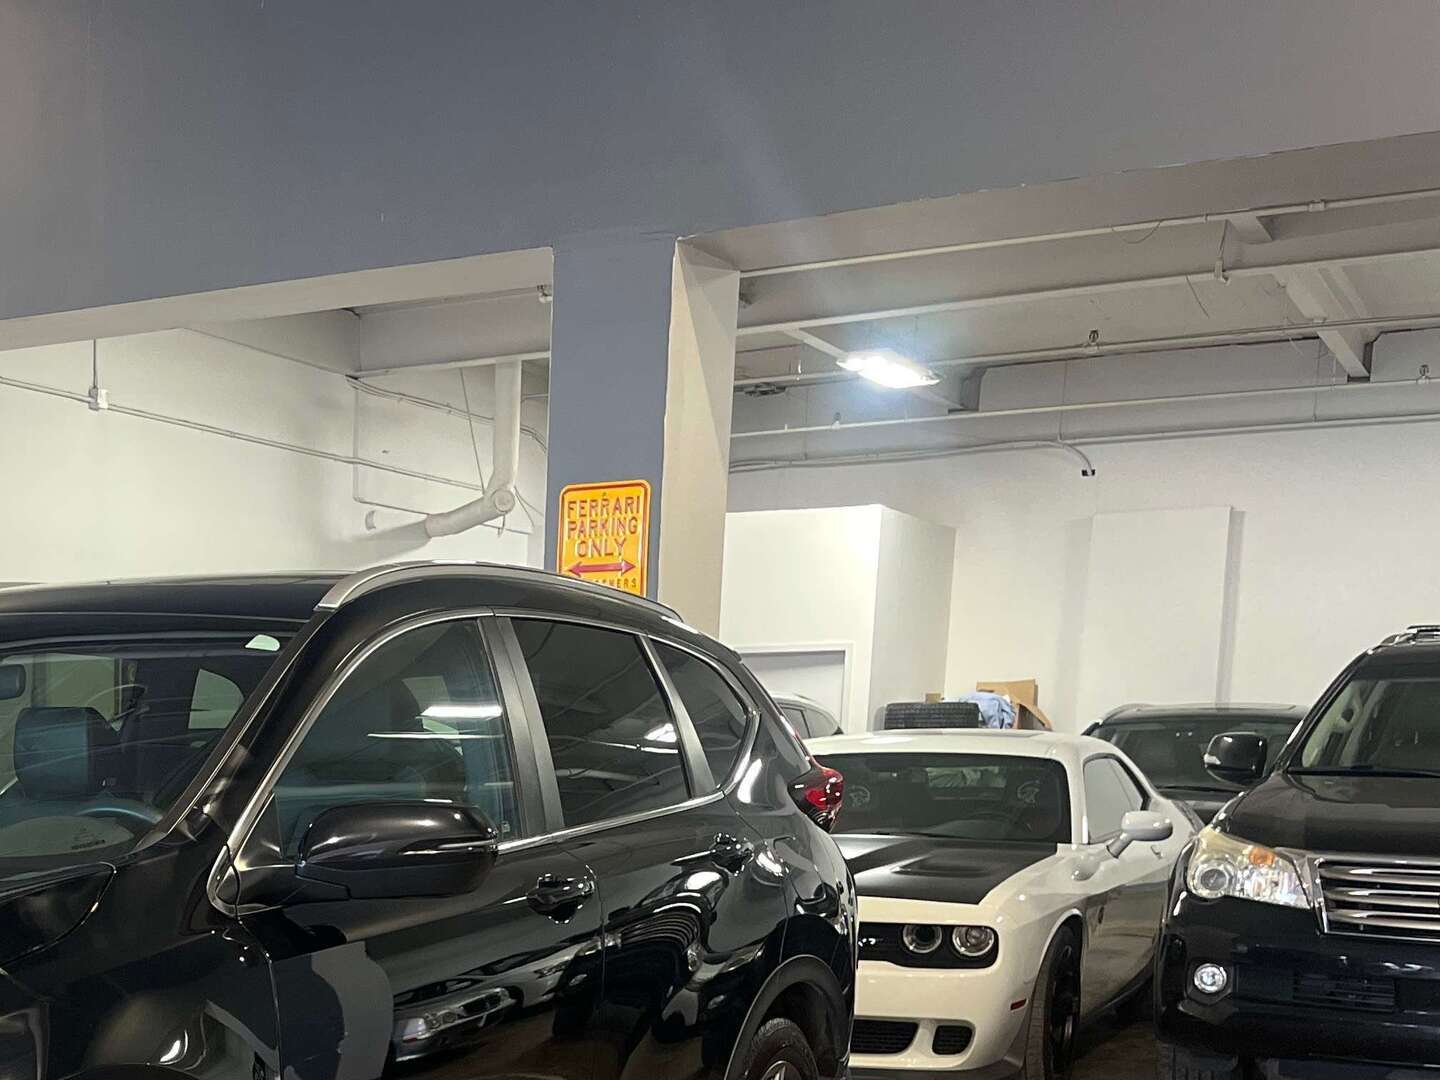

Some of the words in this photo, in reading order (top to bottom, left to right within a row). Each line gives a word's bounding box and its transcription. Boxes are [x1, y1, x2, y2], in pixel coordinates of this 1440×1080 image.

[567, 495, 641, 519] FERRARI
[567, 516, 639, 540] PARKING
[575, 537, 627, 559] ONLY
